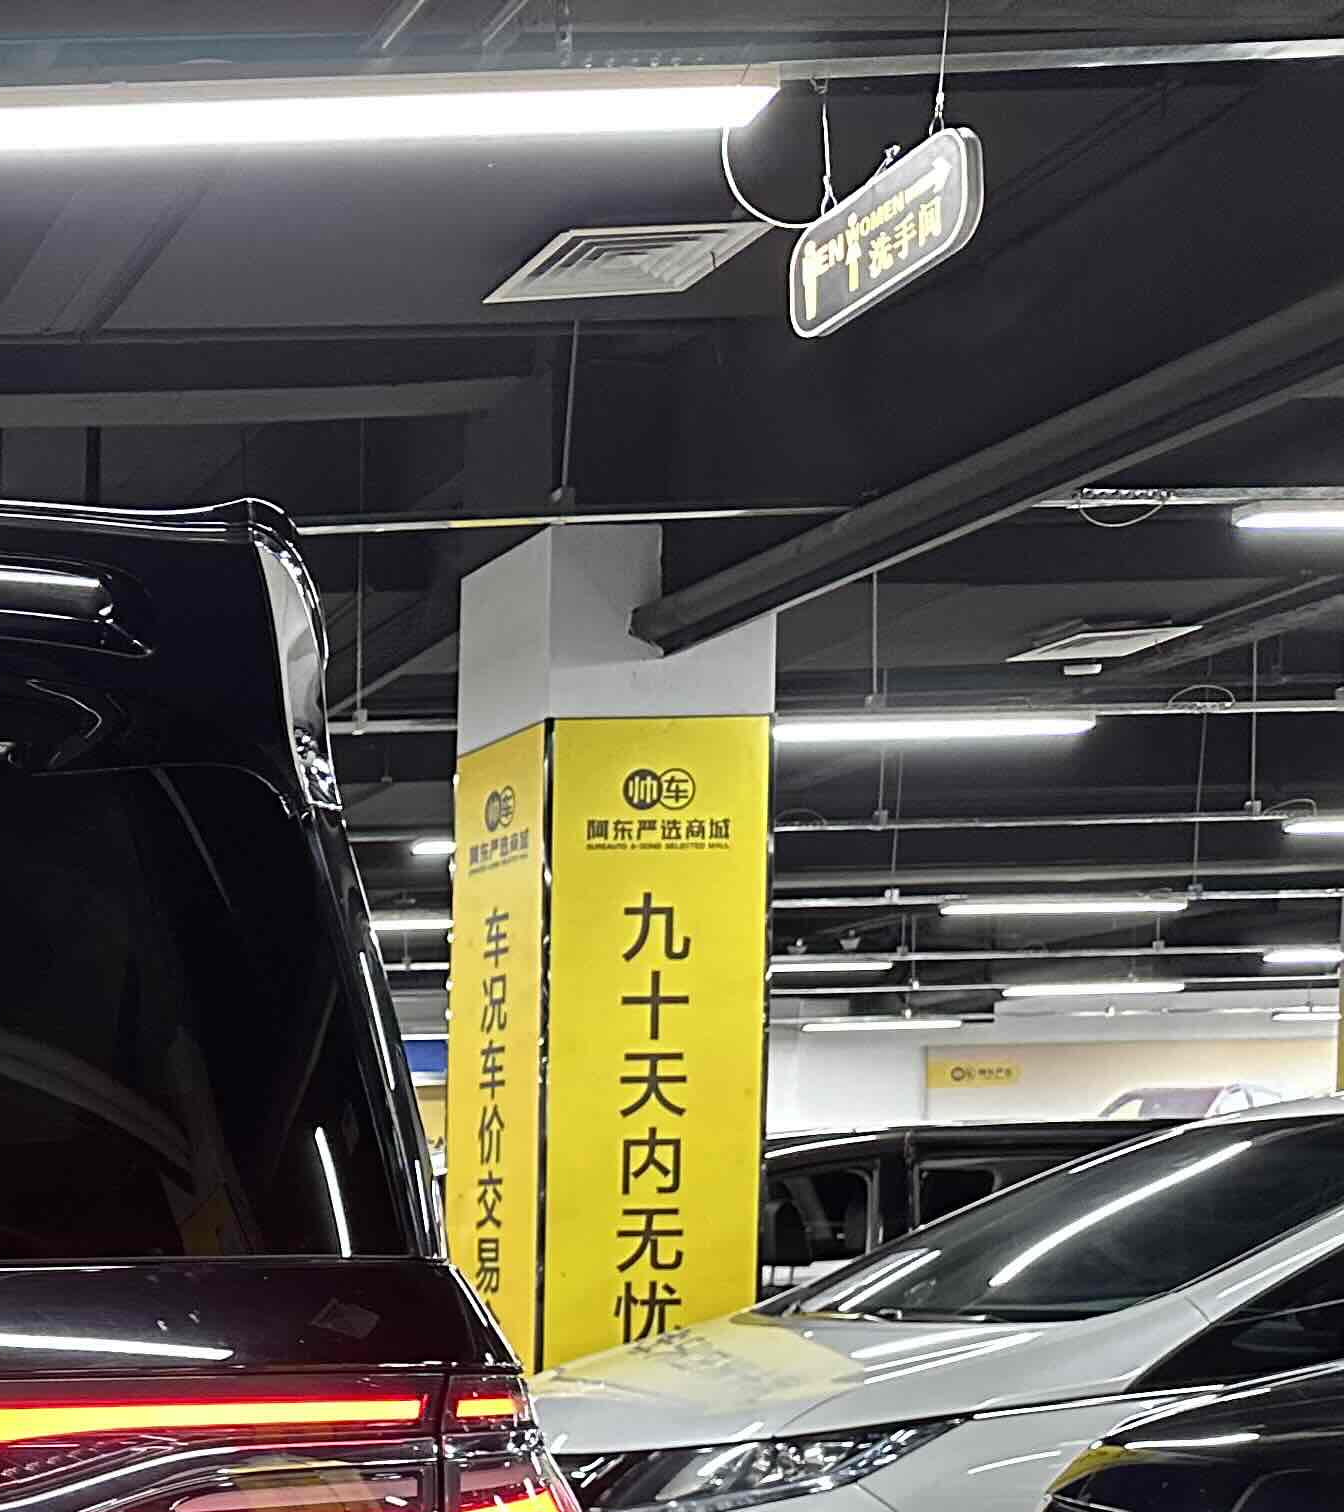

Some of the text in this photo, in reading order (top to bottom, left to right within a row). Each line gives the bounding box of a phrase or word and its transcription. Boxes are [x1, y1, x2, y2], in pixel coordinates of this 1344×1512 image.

[868, 196, 942, 279] 洗手间
[587, 818, 730, 841] 阿东严选商城
[476, 907, 510, 1324] 车况车价交易
[613, 892, 691, 1344] 九十天内无忧
